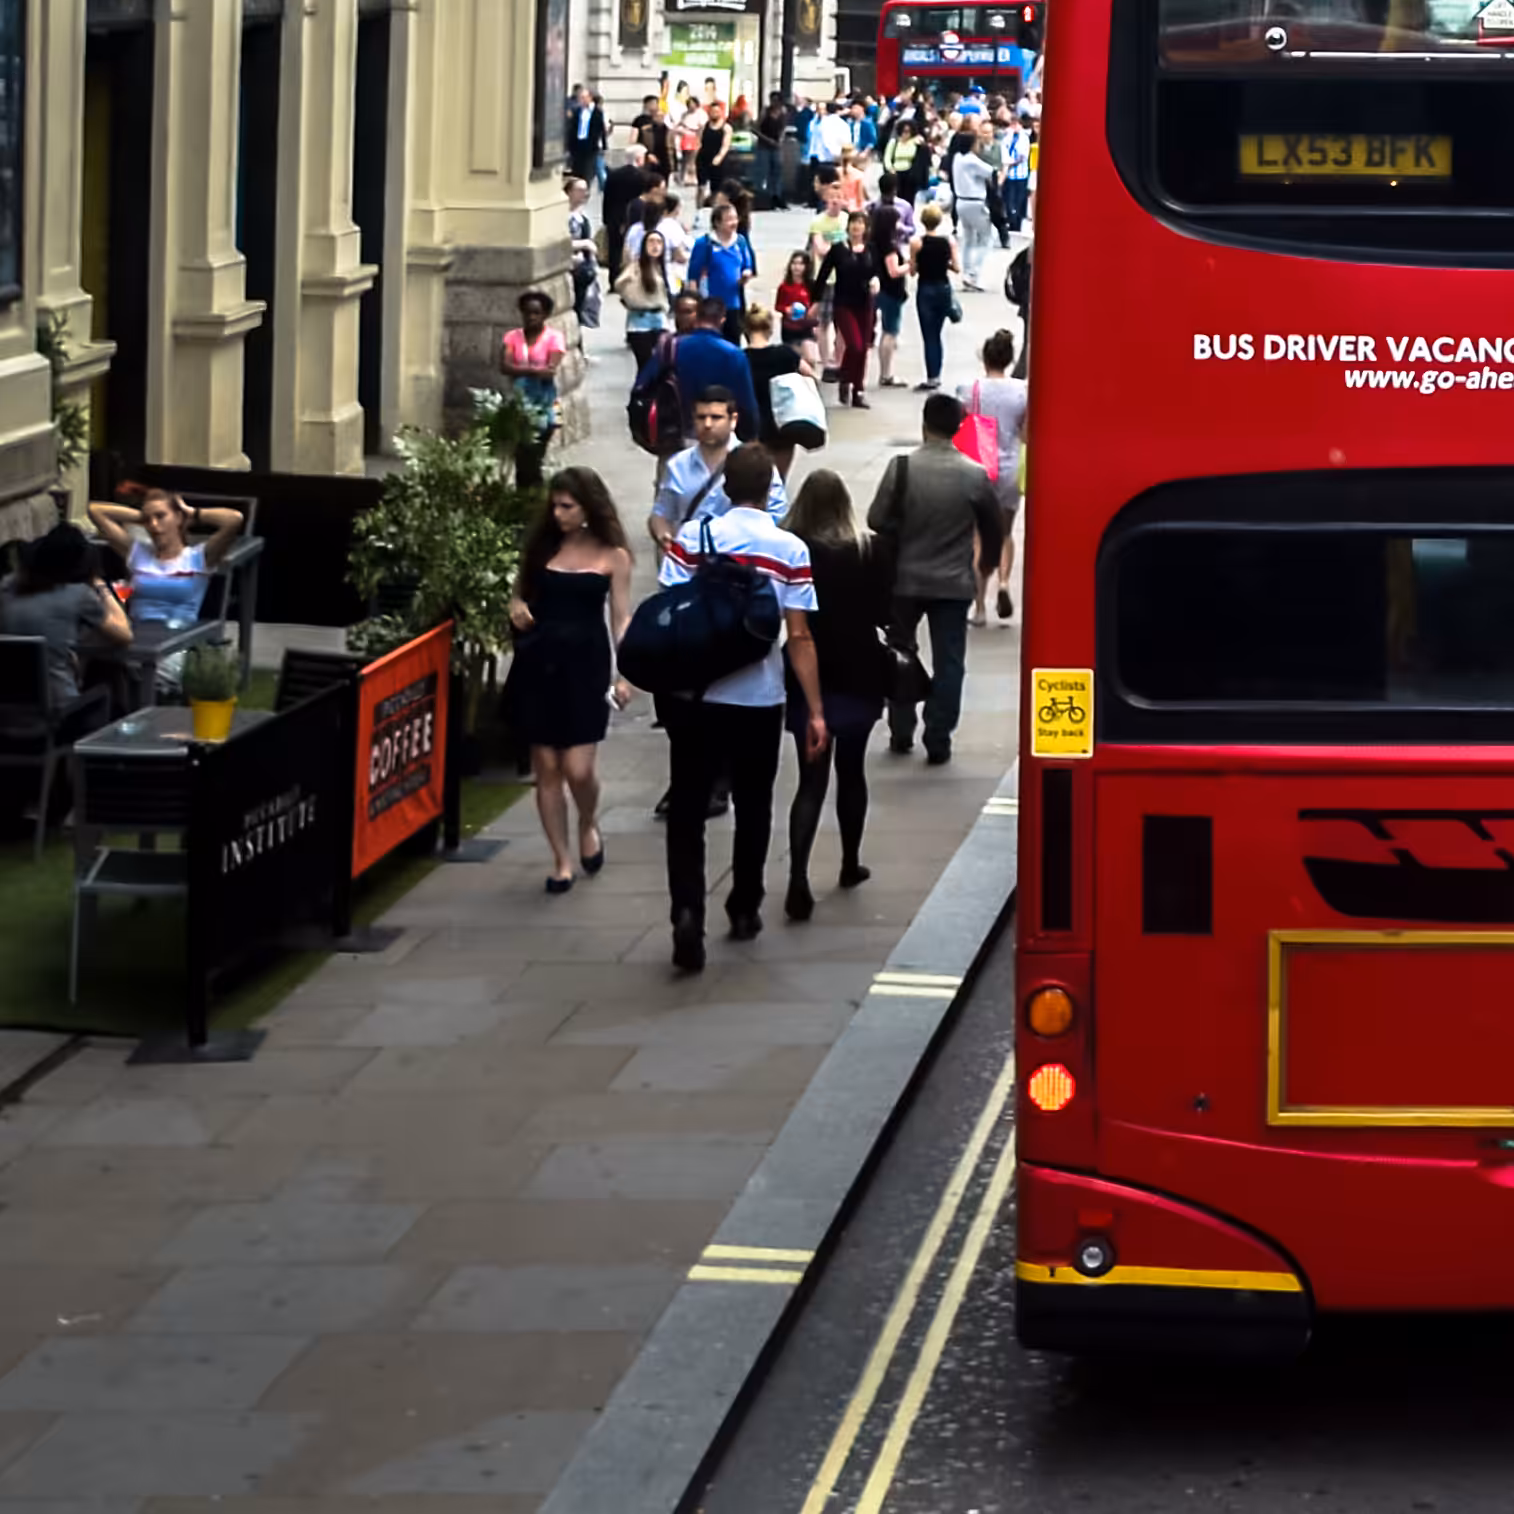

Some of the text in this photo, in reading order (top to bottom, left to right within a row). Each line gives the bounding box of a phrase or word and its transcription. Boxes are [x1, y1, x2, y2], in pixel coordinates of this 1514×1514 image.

[1257, 136, 1436, 168] LX53 BFK
[1194, 334, 1255, 360] BUS
[1263, 334, 1377, 362] DRIVER
[1038, 678, 1086, 693] Cyclists
[1038, 727, 1059, 739] Stay
[369, 712, 433, 785] COFFEE
[222, 793, 318, 874] INSTITUTE
